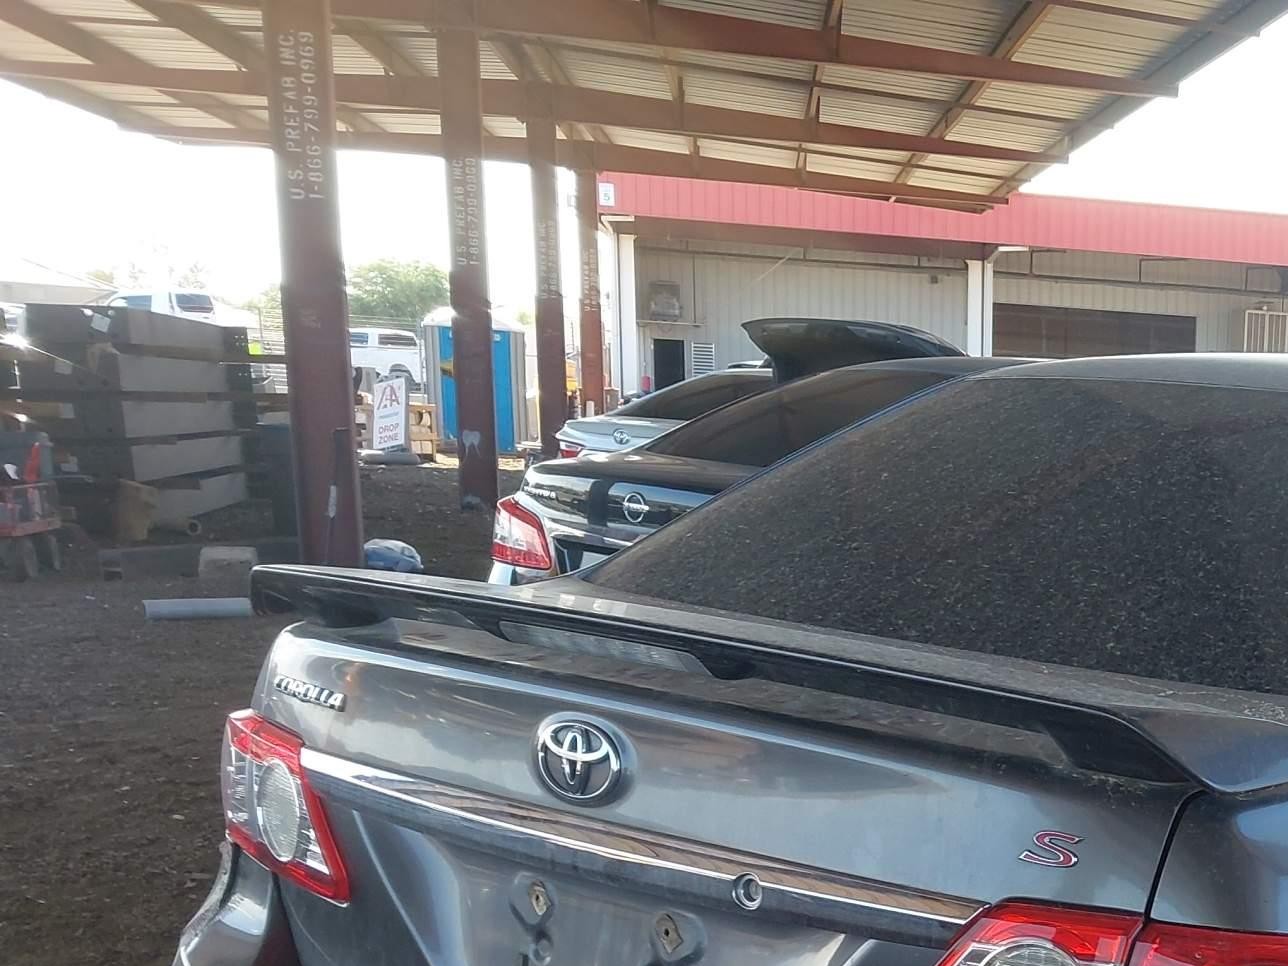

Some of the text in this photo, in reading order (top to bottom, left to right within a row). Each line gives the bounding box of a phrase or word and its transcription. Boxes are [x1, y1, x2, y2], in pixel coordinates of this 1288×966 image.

[280, 76, 302, 152] PREFAB
[298, 31, 325, 199] 1-866-799-0969
[288, 164, 305, 200] U.S.
[378, 422, 400, 435] DROP
[378, 432, 400, 445] ZONE
[274, 675, 345, 710] COROLLA
[1018, 831, 1085, 868] S
